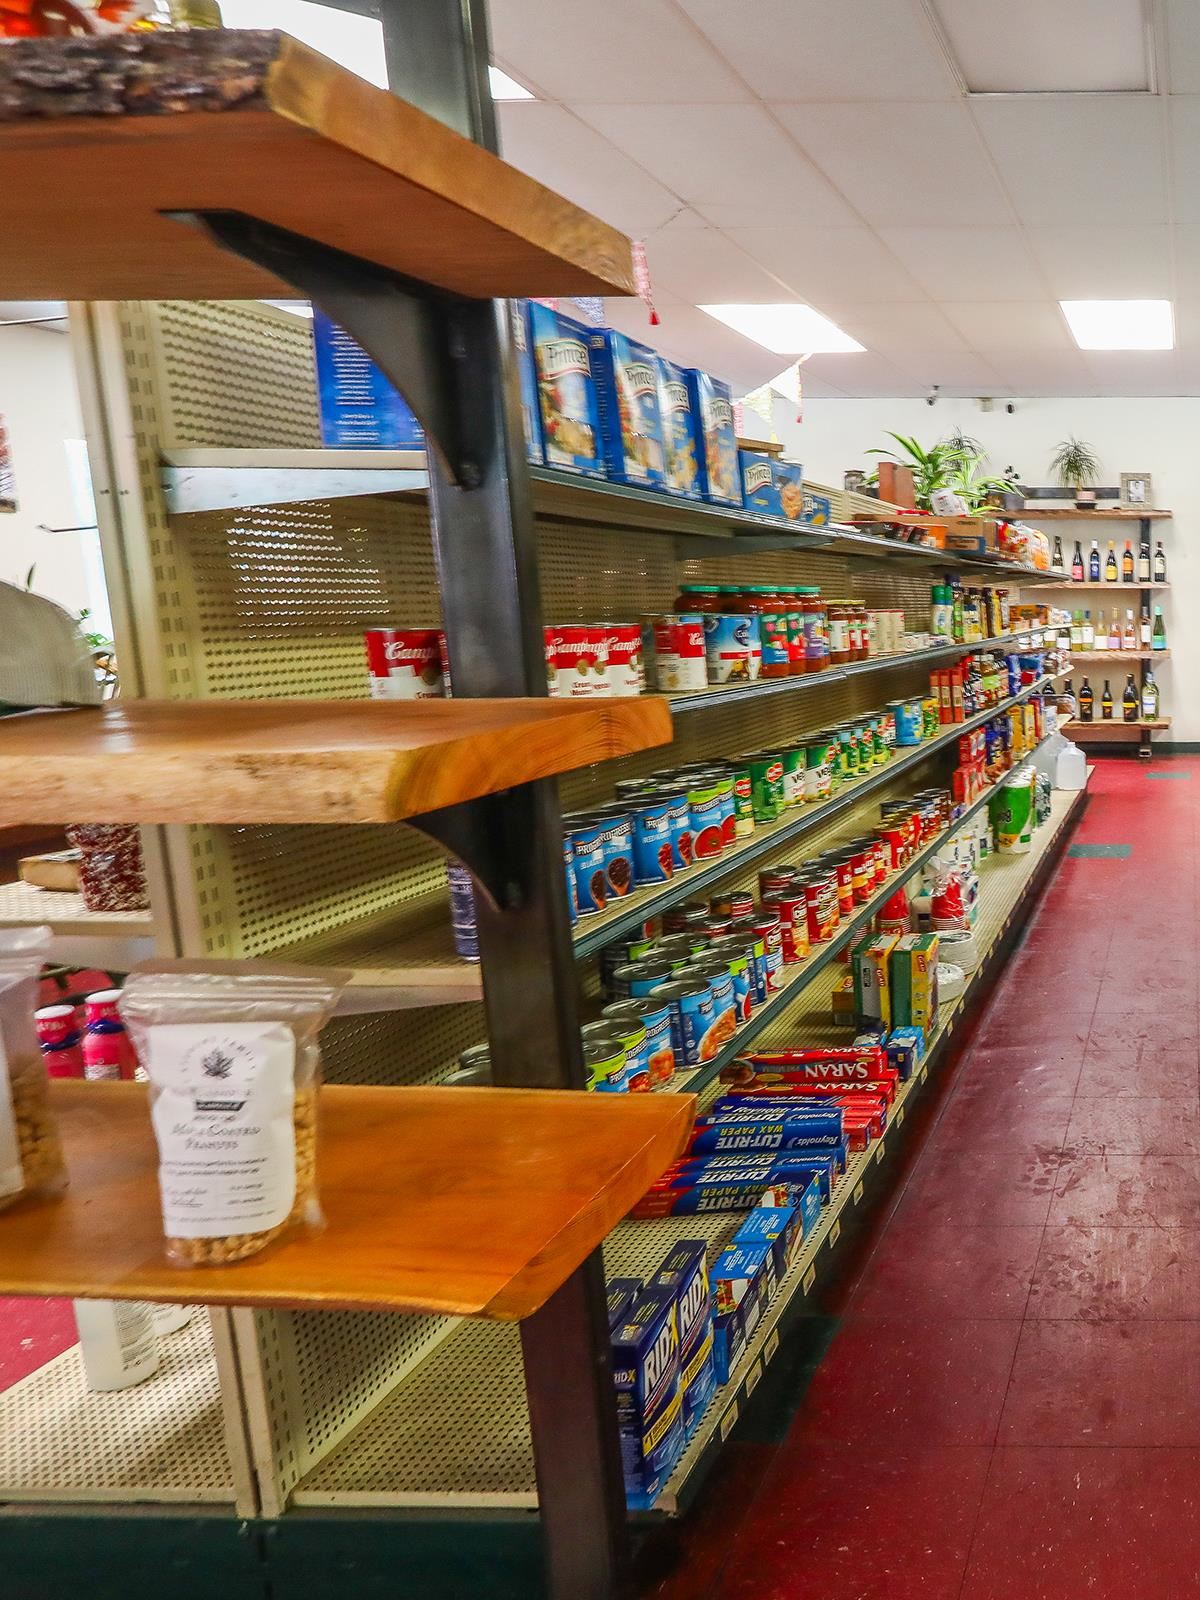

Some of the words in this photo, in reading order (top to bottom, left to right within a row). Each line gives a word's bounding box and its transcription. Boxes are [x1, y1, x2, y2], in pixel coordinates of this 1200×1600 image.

[548, 347, 588, 368] Prince
[805, 1061, 869, 1079] SARAN
[815, 1081, 878, 1092] SARAN
[794, 1112, 839, 1120] Reynolds
[720, 1126, 757, 1138] PAPER
[758, 1124, 784, 1135] WAX
[715, 1133, 784, 1150] CUT-RITE
[797, 1135, 840, 1147] Reynolds
[703, 1157, 777, 1169] CUT-RITE
[787, 1155, 832, 1164] Reynolds
[695, 1168, 772, 1184] CUT-RITE
[702, 1185, 741, 1199] PAPER
